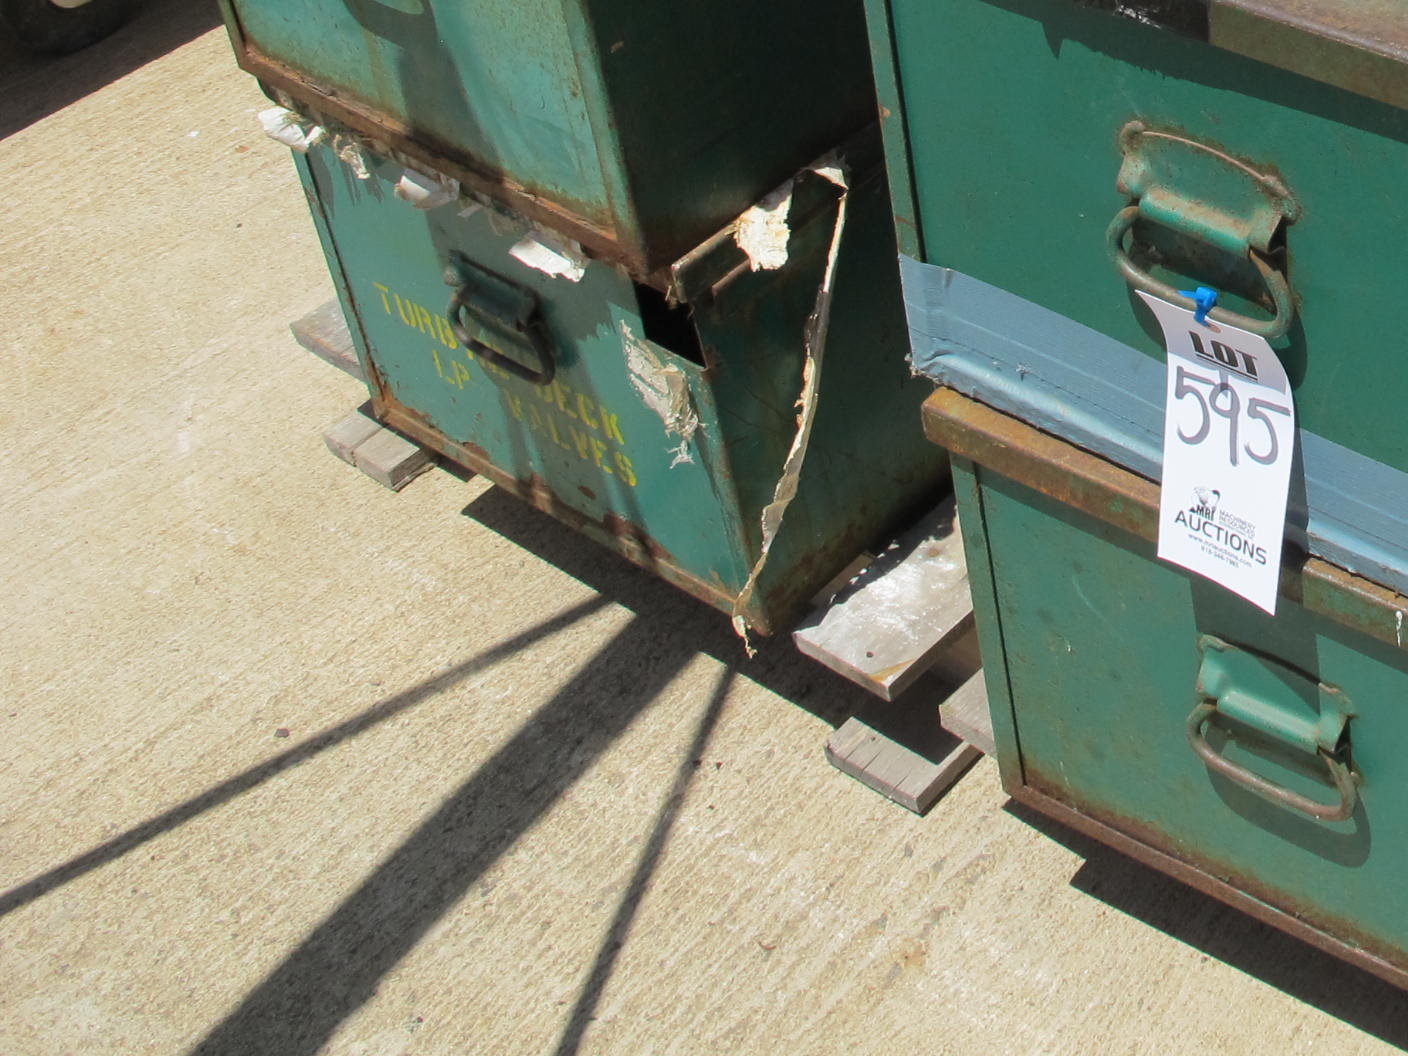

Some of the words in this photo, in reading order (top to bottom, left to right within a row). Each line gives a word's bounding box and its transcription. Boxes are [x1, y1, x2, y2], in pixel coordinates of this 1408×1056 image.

[432, 348, 471, 390] LP
[1188, 330, 1259, 380] LOT
[1173, 364, 1292, 468] 595
[1174, 509, 1268, 566] AUCTIONS
